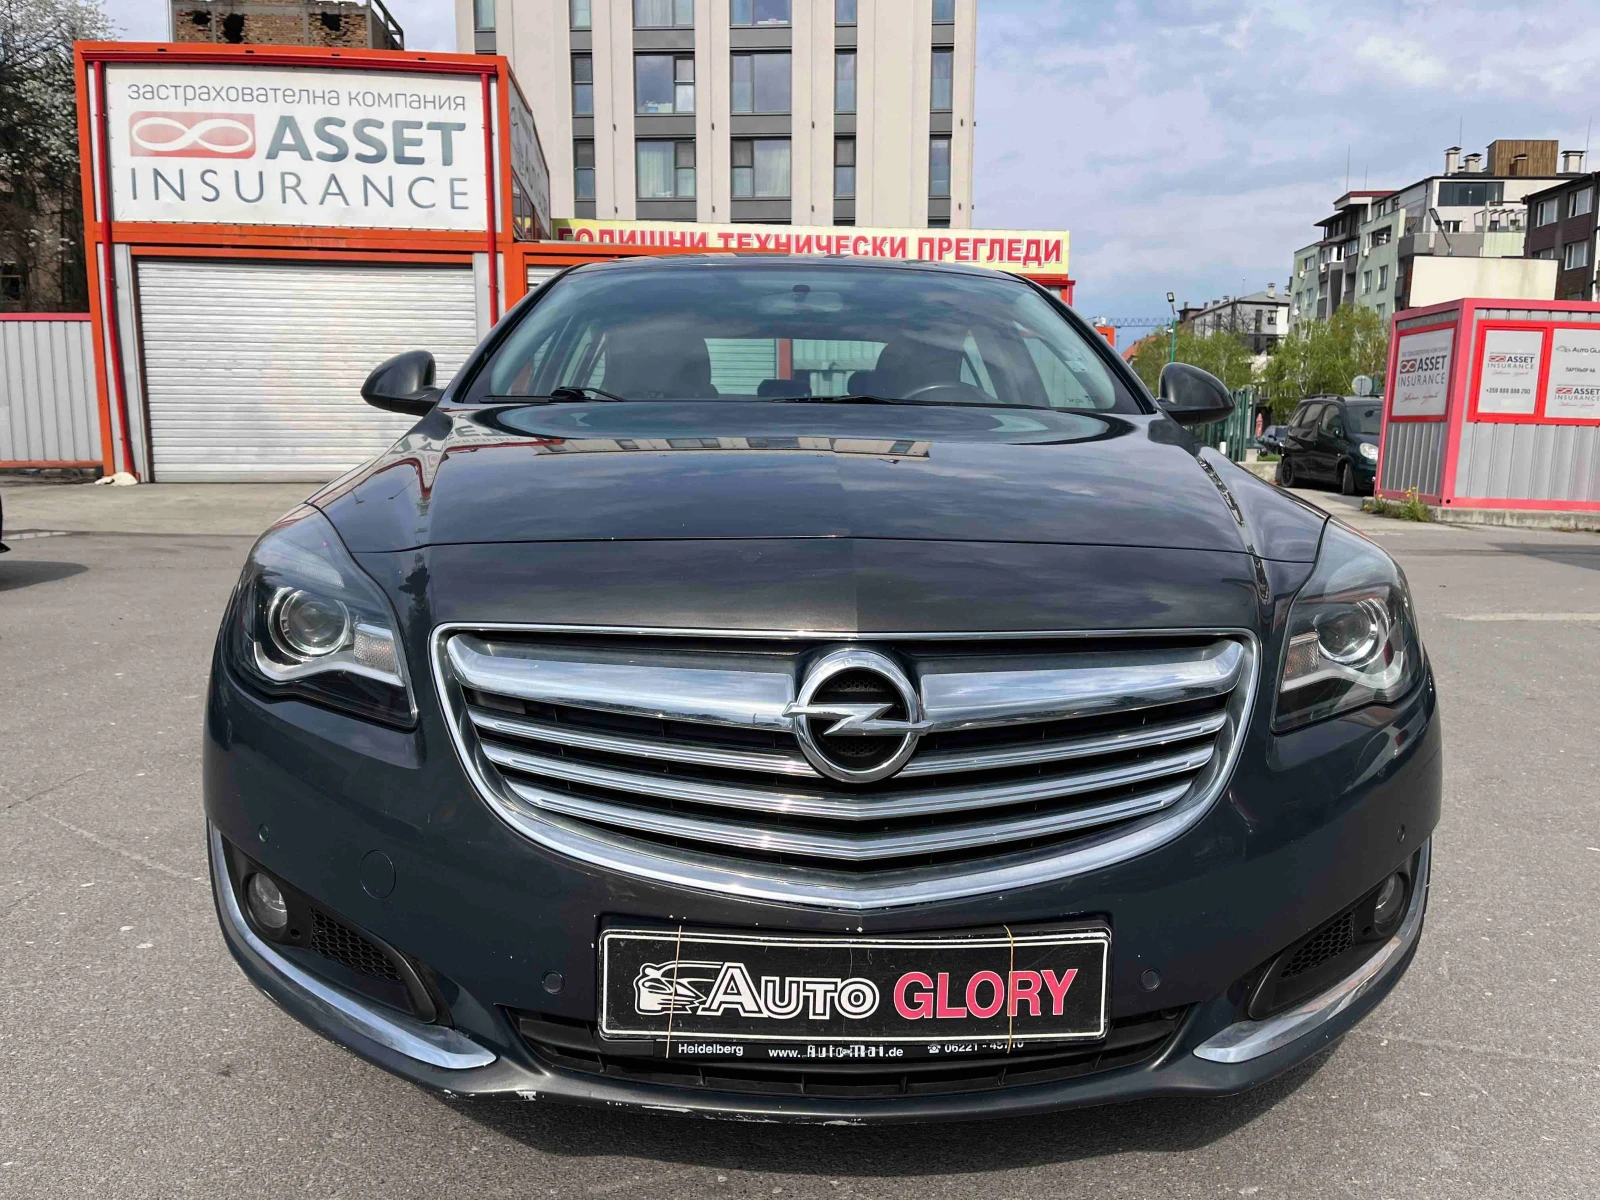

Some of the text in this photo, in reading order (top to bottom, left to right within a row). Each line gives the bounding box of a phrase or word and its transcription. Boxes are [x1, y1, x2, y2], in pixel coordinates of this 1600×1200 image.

[127, 82, 467, 112] застрахователна компания
[265, 115, 467, 167] ASSET
[130, 167, 470, 211] INSURANCE
[717, 232, 907, 258] ТЕХНИЧЕСКИ
[917, 237, 1062, 268] ПРЕГЛЕДИ
[1416, 354, 1448, 373] ASSET
[1487, 362, 1534, 370] INSURANCE
[1506, 355, 1536, 364] ASSET
[1397, 372, 1446, 388] INSURANCE
[1554, 394, 1600, 402] INSURANCE
[1573, 387, 1600, 396] ASSET
[893, 968, 1079, 1021] GLORY
[678, 1043, 744, 1057] Heidelberg
